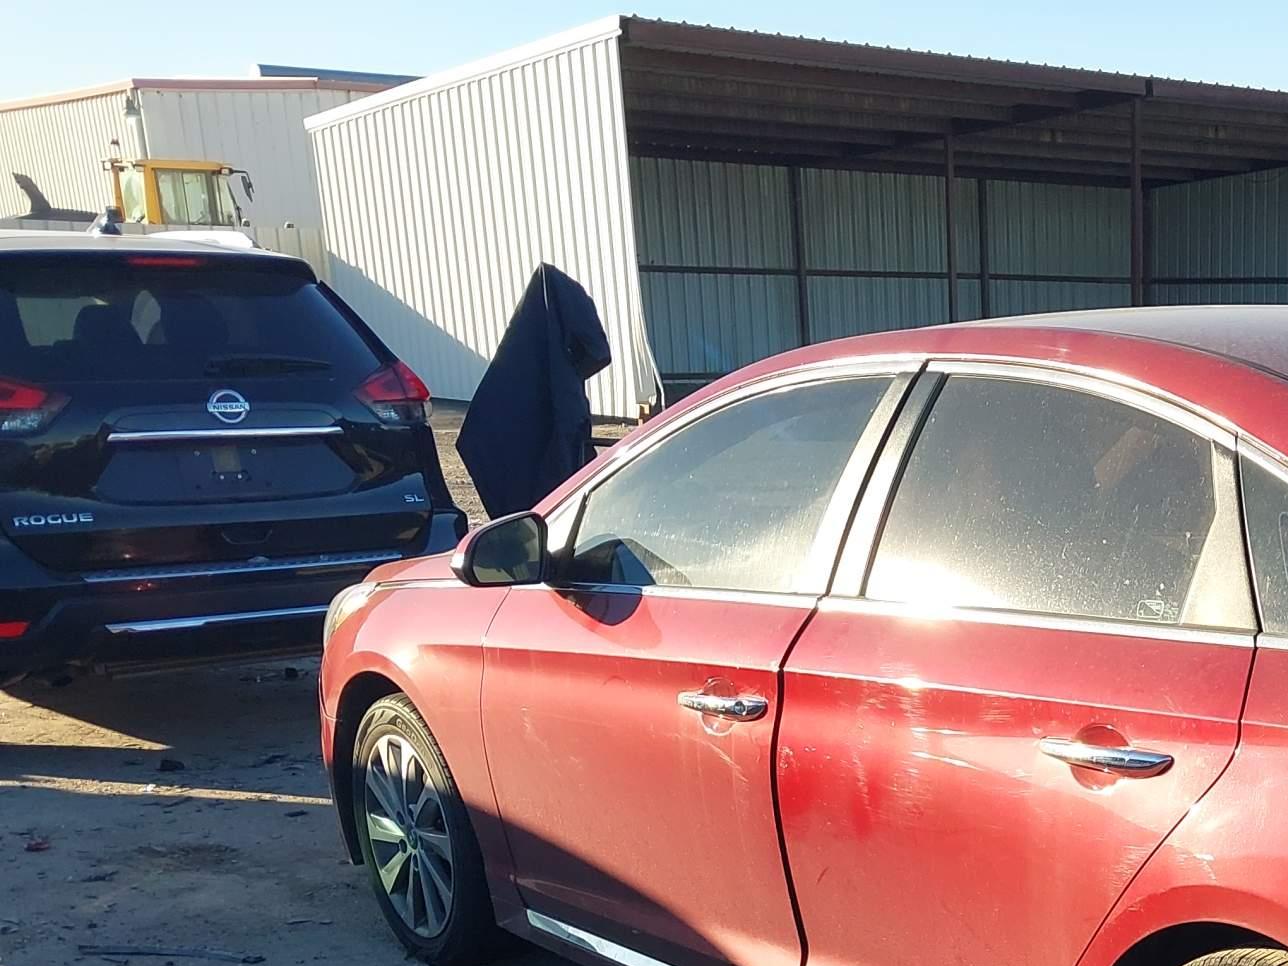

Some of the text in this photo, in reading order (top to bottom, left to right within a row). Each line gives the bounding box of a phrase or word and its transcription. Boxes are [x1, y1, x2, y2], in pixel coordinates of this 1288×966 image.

[212, 402, 246, 411] NISSAN
[403, 494, 425, 502] SL
[13, 512, 94, 527] ROGUE
